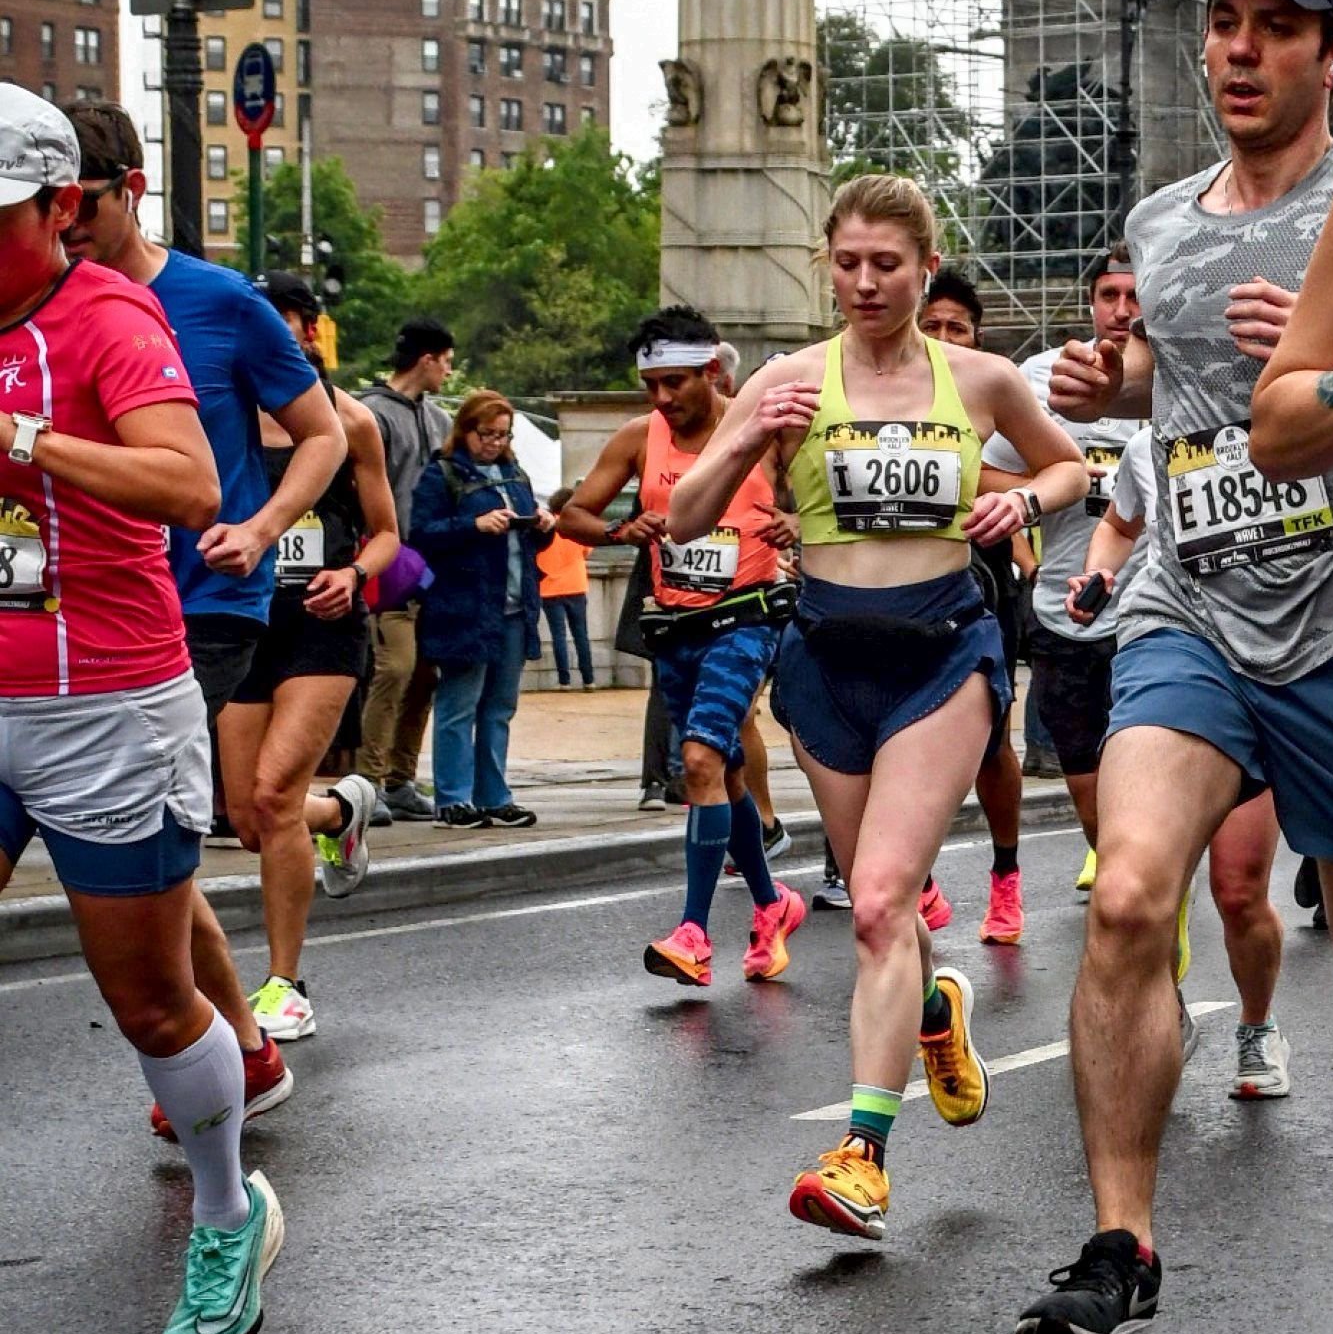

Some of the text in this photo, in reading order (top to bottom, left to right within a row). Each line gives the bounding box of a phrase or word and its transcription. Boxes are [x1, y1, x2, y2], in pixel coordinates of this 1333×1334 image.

[865, 459, 940, 497] 2606
[1176, 488, 1199, 532] E
[1291, 513, 1327, 533] TFK
[683, 547, 722, 573] 4271
